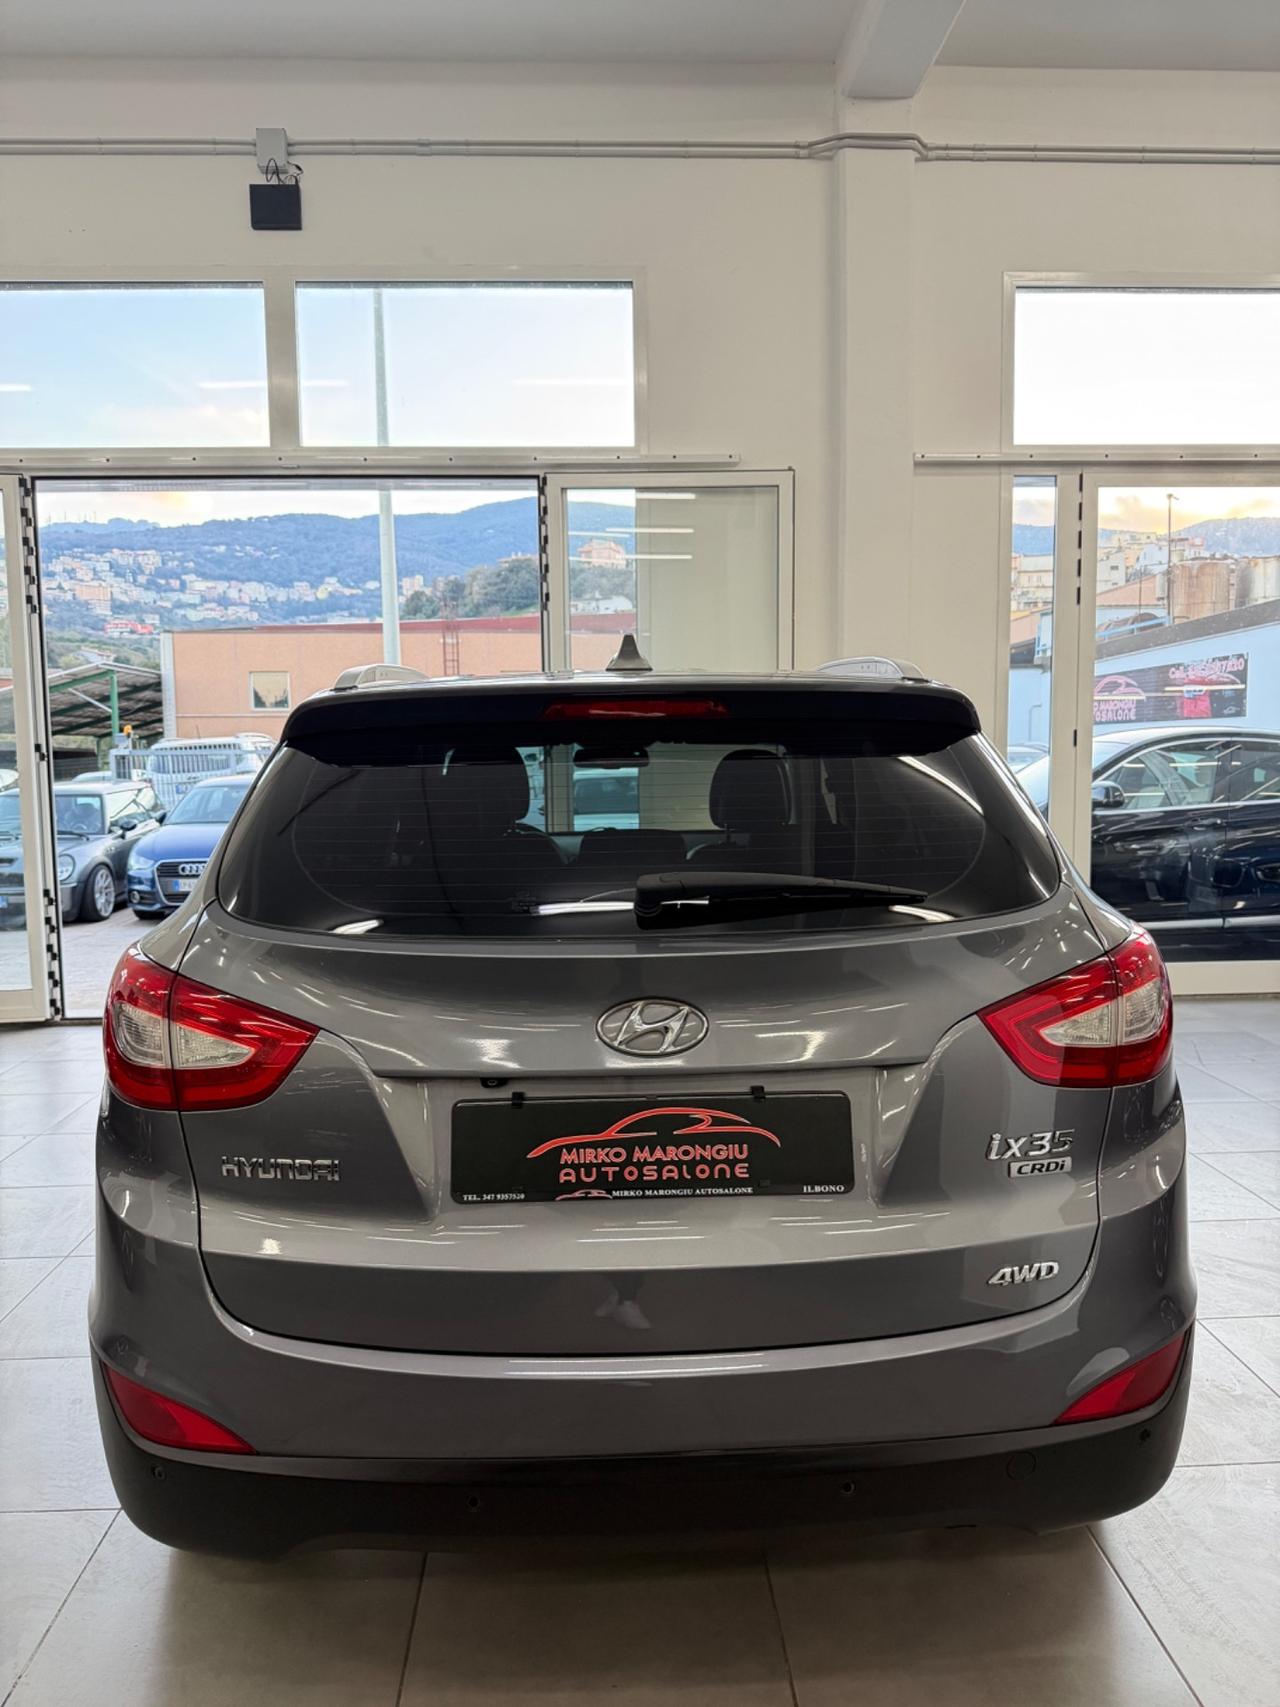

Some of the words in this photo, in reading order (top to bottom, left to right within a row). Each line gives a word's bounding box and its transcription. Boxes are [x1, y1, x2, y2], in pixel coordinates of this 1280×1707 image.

[1094, 709, 1136, 722] OSALONE
[560, 1147, 627, 1165] MIRKO
[632, 1143, 749, 1163] MARONGIU
[987, 1129, 1075, 1160] ix35
[221, 1156, 340, 1181] HYUNDAI
[559, 1163, 750, 1184] AUTOSALONE
[1016, 1160, 1066, 1176] CRDi
[644, 1188, 694, 1196] MARONGIU
[695, 1187, 753, 1195] AUTOSALONE
[803, 1185, 845, 1193] ILBONO
[988, 1261, 1060, 1286] 4WD
